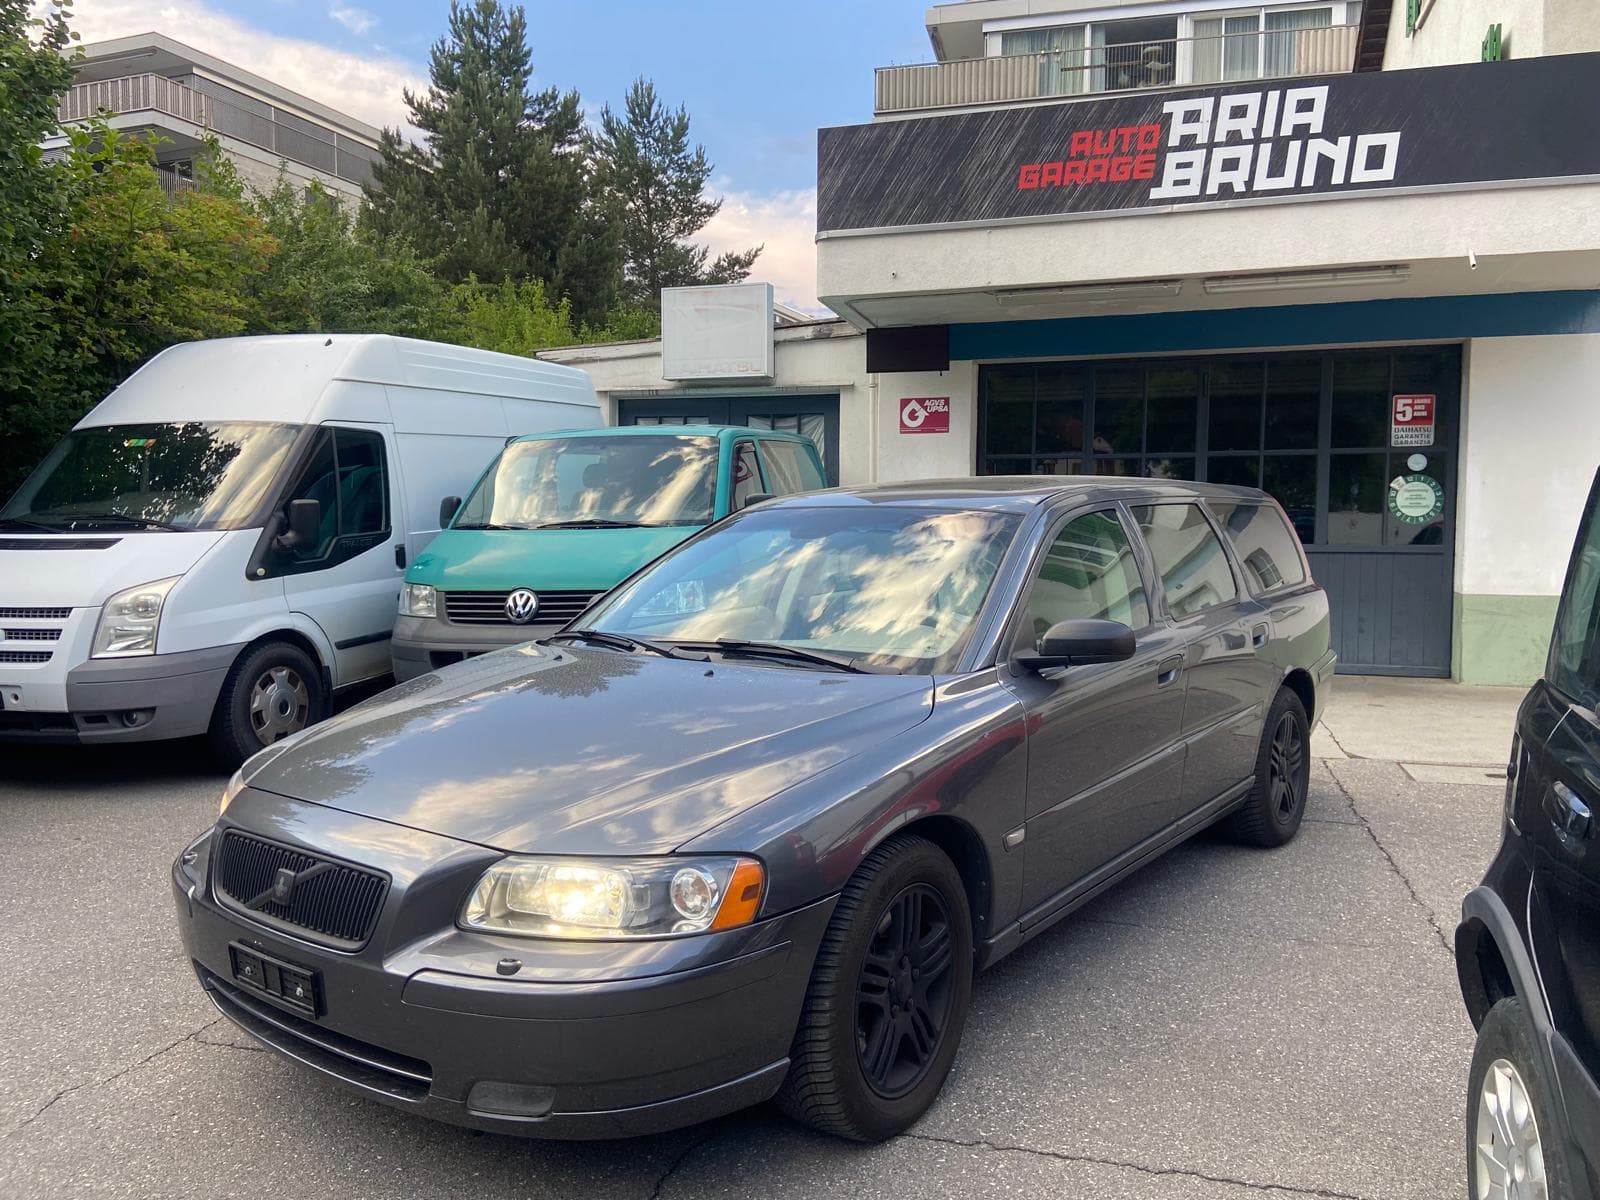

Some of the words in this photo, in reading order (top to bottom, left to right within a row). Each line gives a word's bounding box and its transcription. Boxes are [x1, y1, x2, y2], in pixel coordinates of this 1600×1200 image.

[1163, 85, 1330, 147] ARIA
[1070, 123, 1162, 158] AUTO
[1017, 153, 1157, 190] GARAGE
[1149, 131, 1402, 200] BRUNO
[924, 399, 945, 407] AGVS
[1395, 398, 1413, 422] 5
